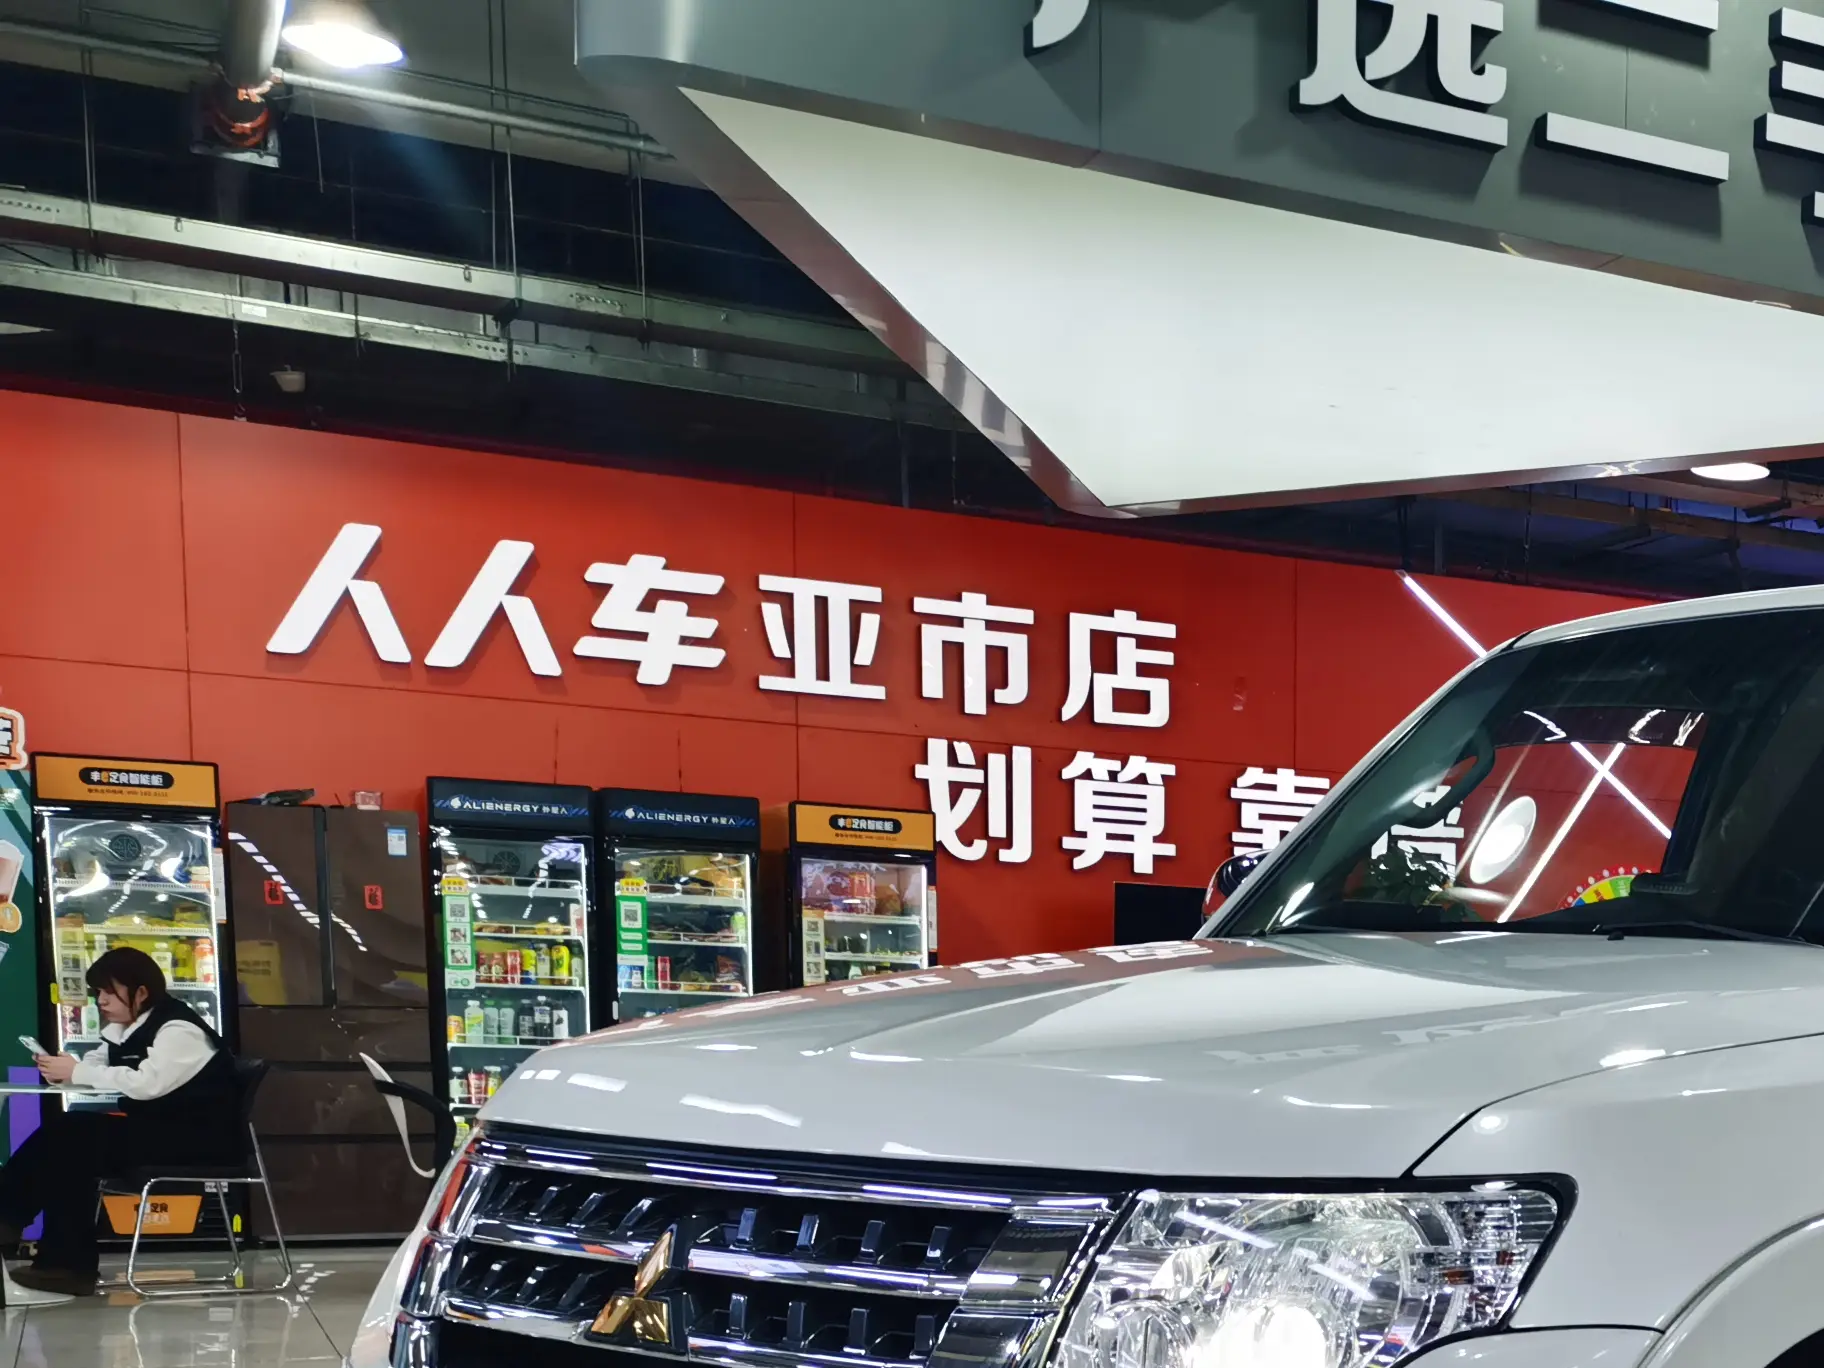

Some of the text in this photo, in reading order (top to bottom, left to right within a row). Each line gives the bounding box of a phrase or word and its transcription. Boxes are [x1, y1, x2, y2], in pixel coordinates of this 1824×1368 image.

[463, 801, 539, 813] ALIENERGY
[914, 737, 1178, 874] 划算
[637, 811, 708, 824] ALIENERGY
